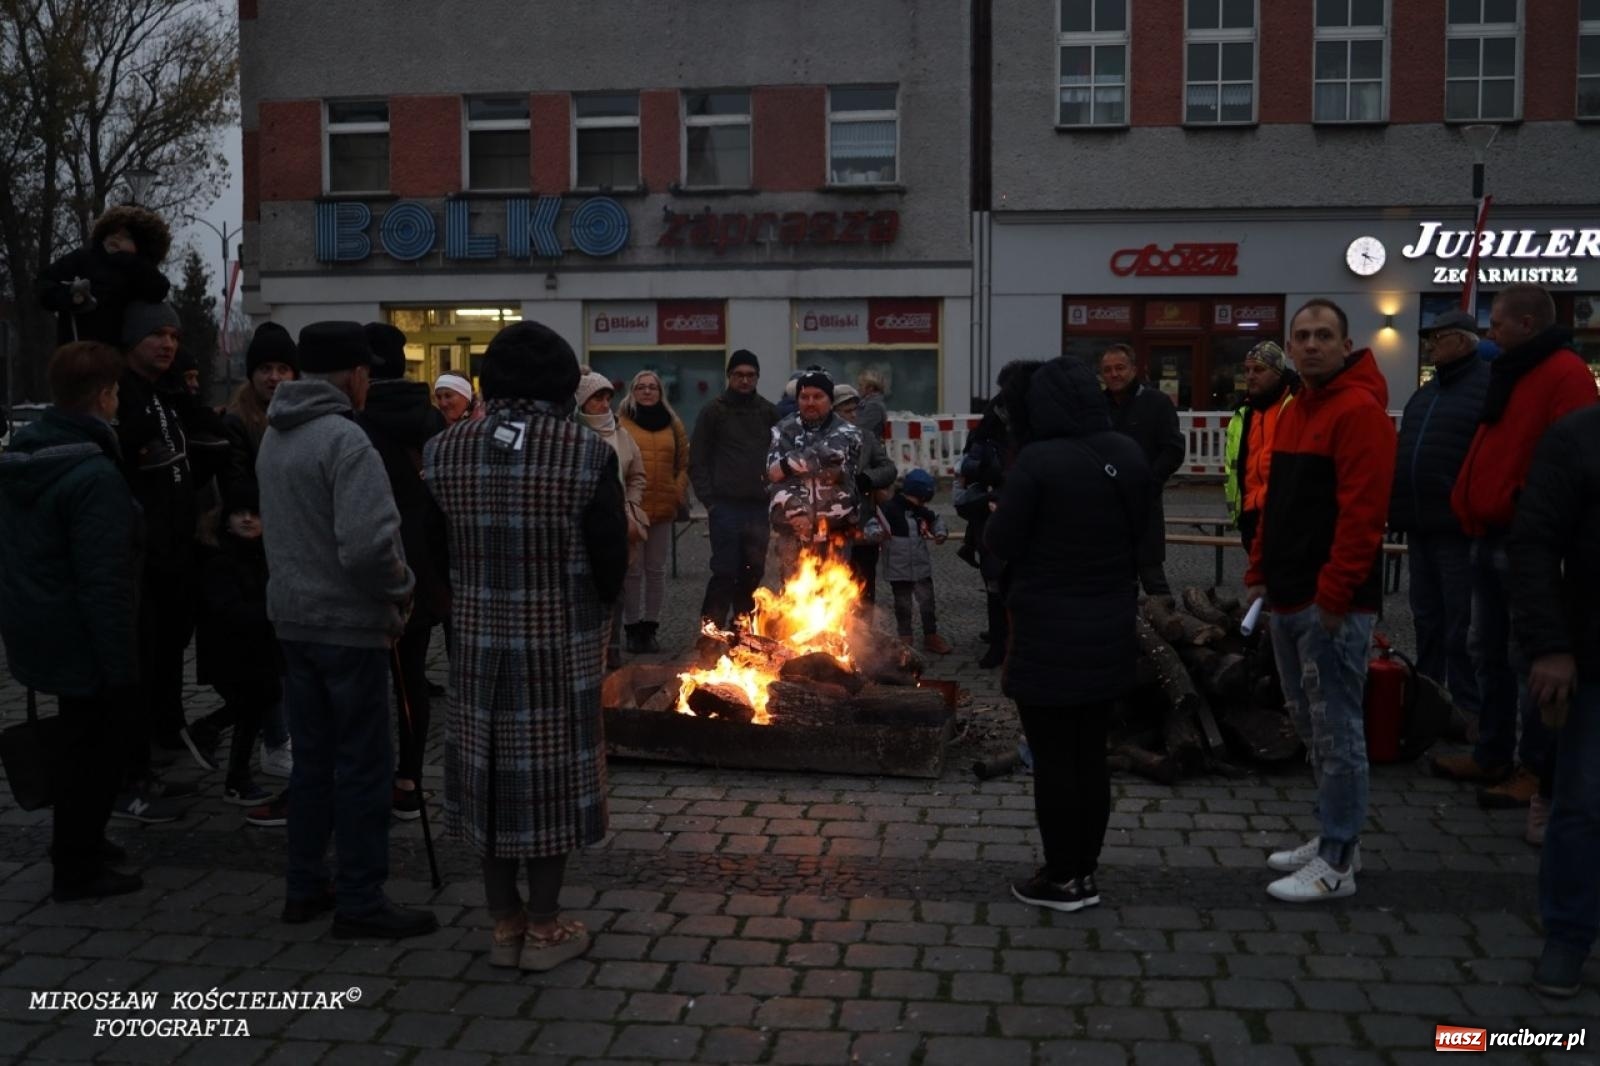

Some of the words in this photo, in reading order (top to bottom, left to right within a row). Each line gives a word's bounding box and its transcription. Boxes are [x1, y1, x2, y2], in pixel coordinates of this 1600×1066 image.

[315, 195, 630, 262] BOLKO
[657, 208, 900, 256] zaprasza
[1401, 221, 1600, 259] JUBILER
[611, 315, 649, 329] Bliski
[819, 313, 859, 328] Bliski
